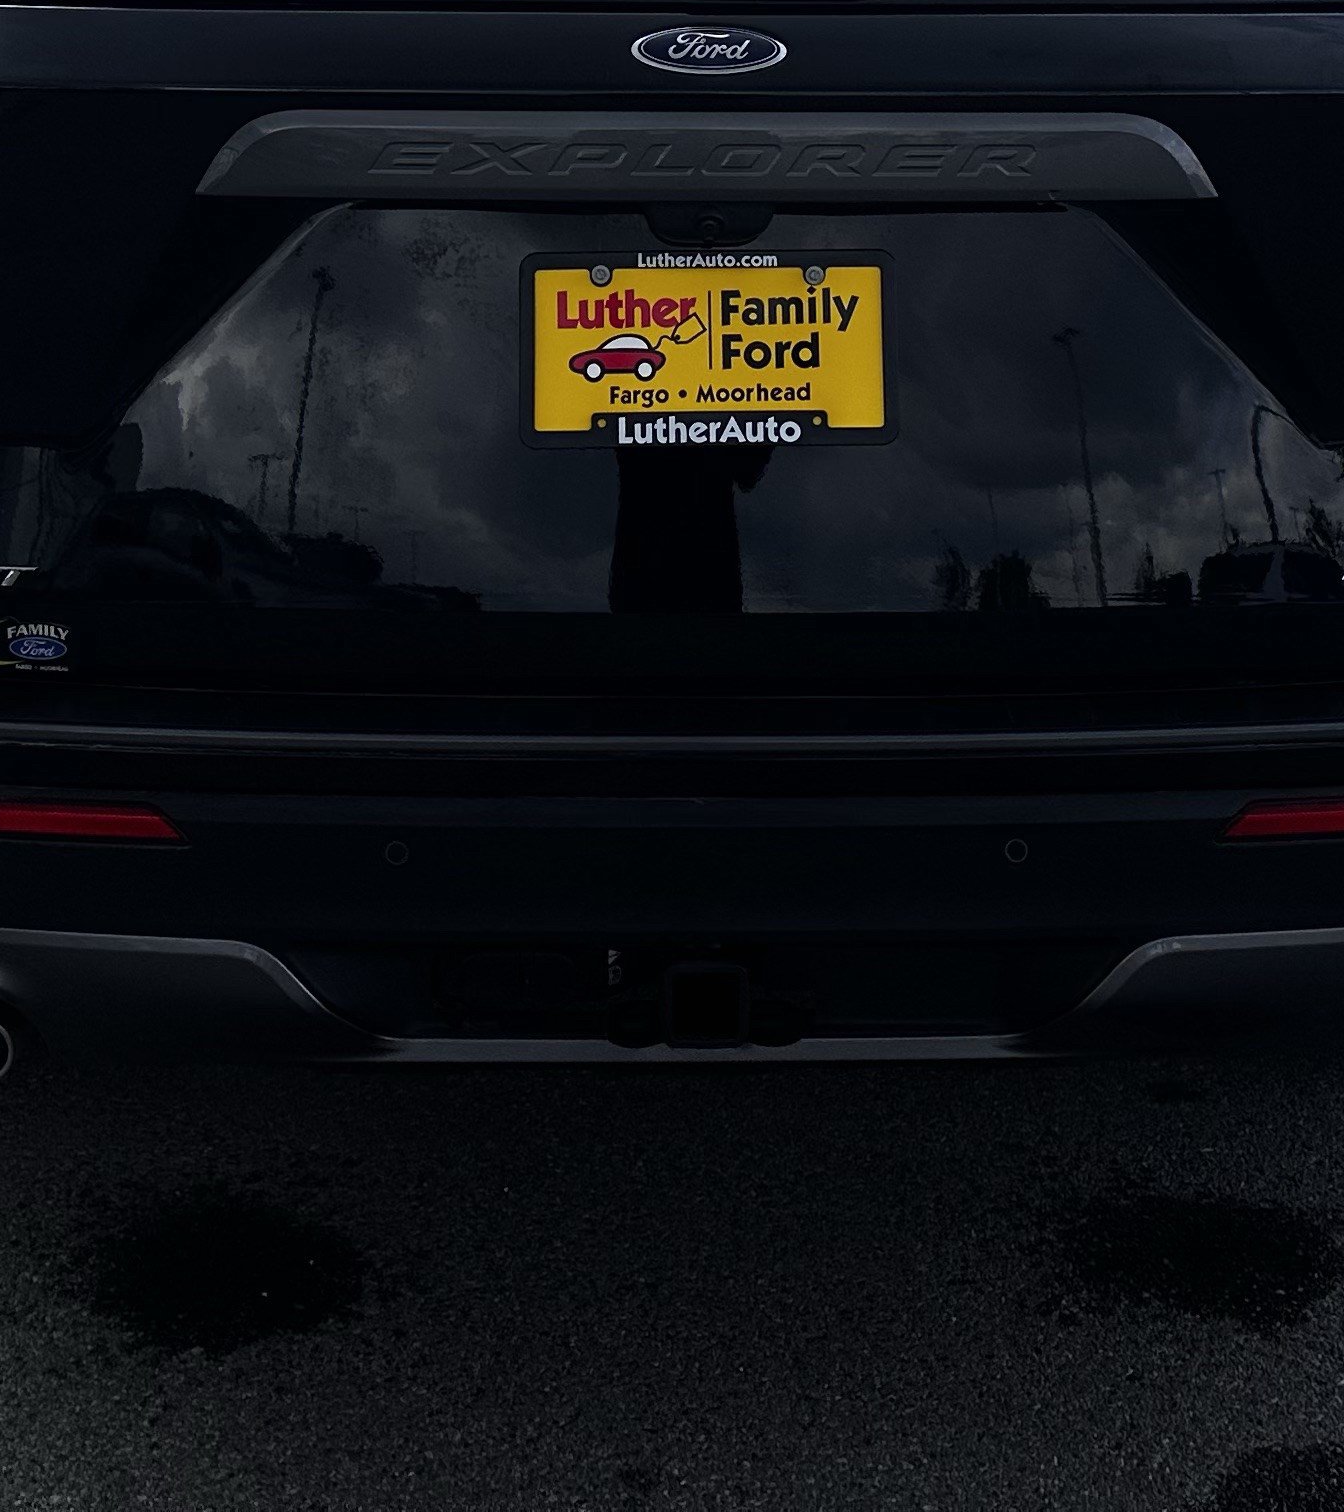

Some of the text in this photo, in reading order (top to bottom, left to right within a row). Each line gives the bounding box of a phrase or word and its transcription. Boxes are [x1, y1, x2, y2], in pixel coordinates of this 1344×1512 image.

[668, 32, 751, 60] Ford
[366, 141, 1041, 178] EXPLORER
[637, 252, 779, 268] LutherAuto.com
[556, 289, 697, 330] Luther
[720, 286, 860, 332] Family
[721, 332, 821, 370] Ford
[609, 383, 812, 408] Fargo Moorhead
[617, 415, 803, 445] LutherAuto
[6, 623, 70, 641] FAMILY
[19, 639, 56, 657] Ford
